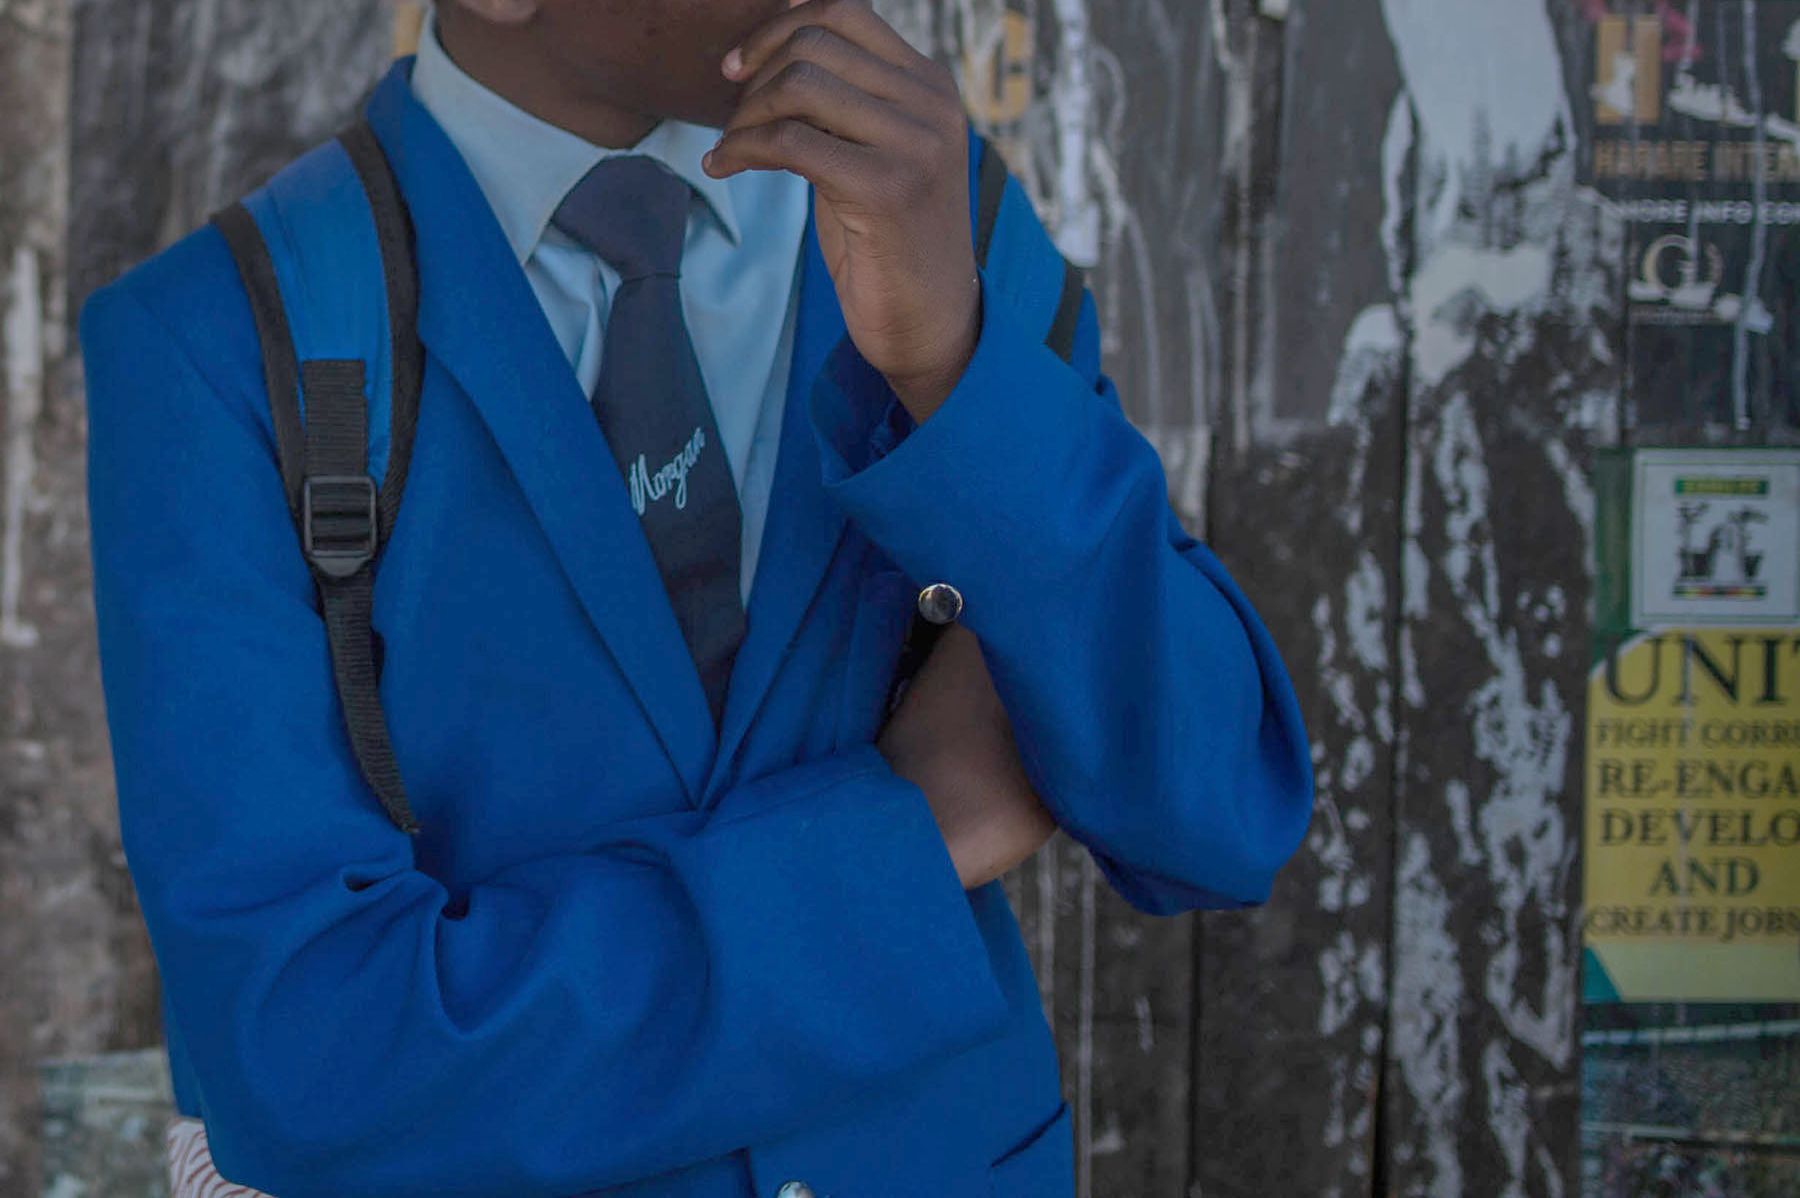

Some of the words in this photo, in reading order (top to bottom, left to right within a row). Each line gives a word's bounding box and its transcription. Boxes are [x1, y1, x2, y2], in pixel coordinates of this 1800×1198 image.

[1605, 634, 1800, 706] UNI
[1701, 718, 1800, 749] CORR
[1650, 857, 1762, 898] AND
